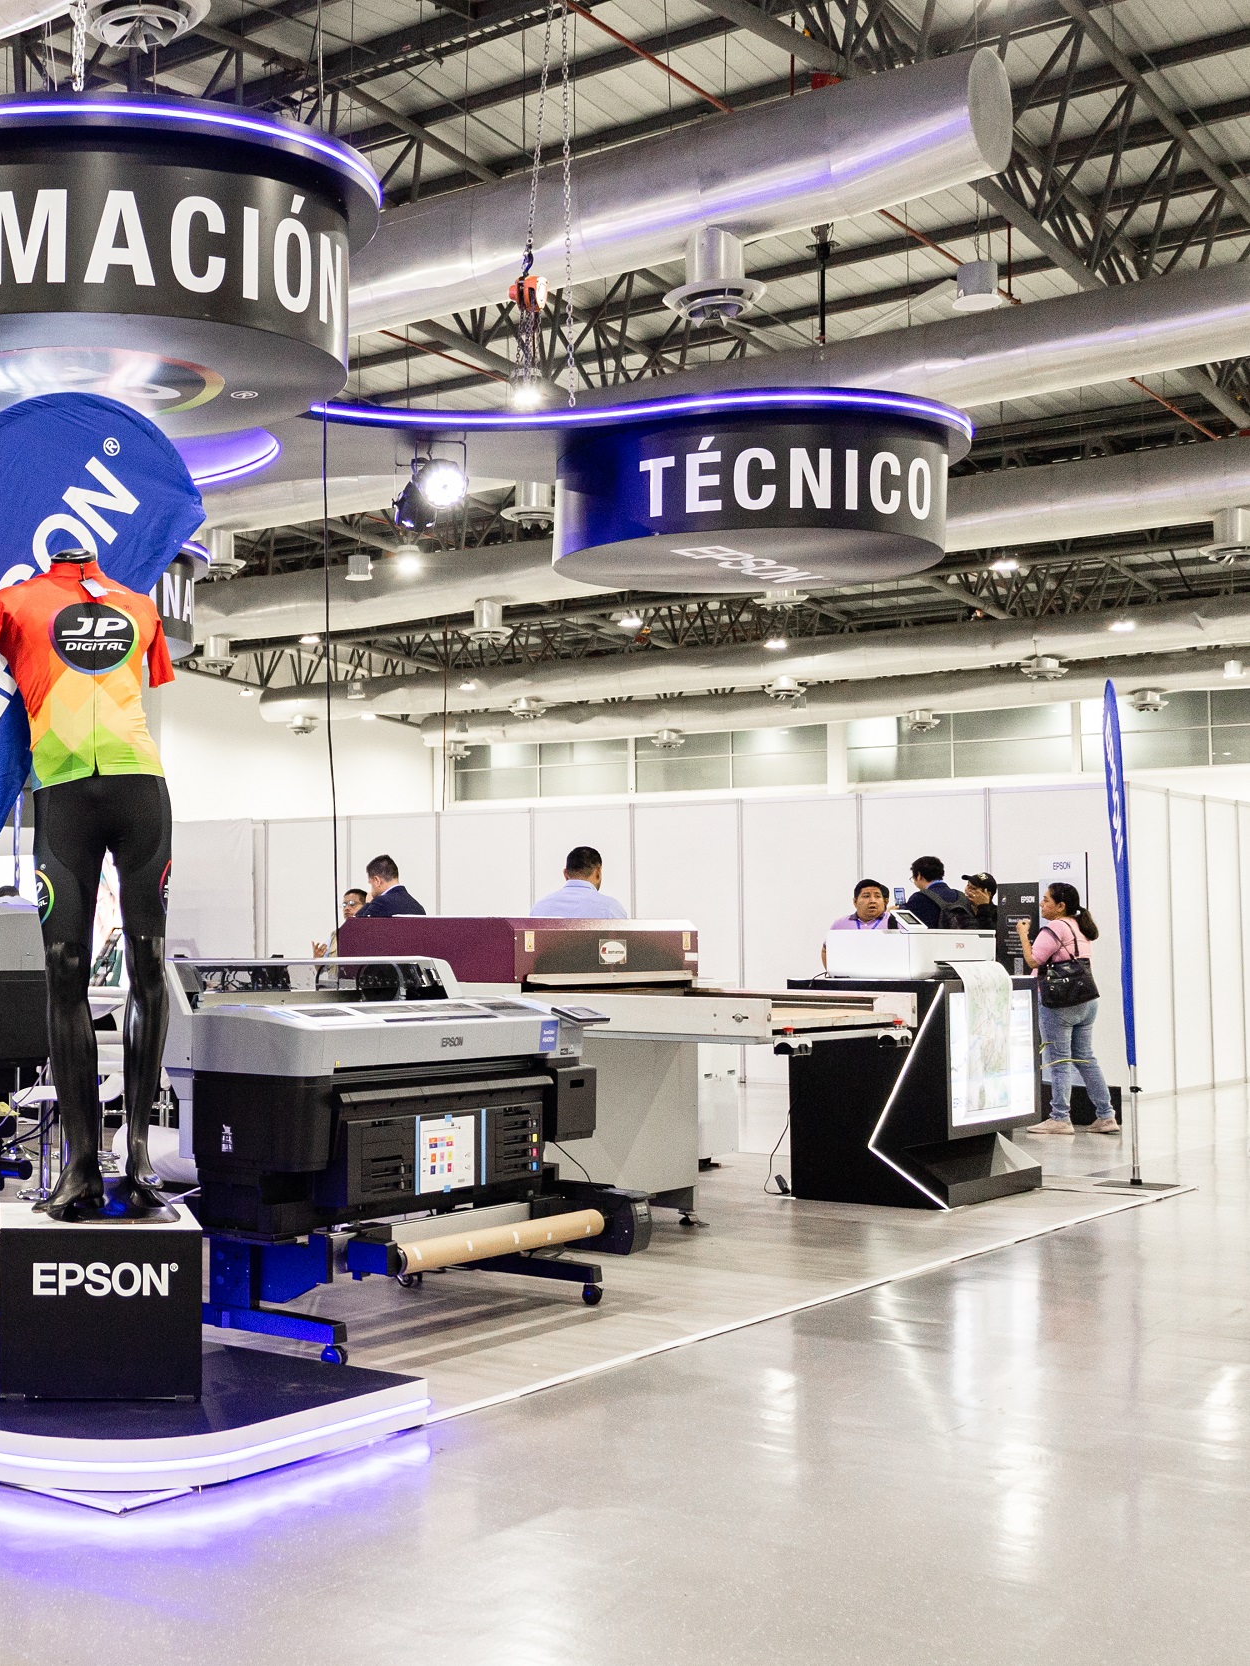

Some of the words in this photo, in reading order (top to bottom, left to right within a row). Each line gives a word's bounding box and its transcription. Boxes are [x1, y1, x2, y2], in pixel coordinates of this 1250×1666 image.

[639, 436, 931, 520] TÉCNICO
[61, 617, 128, 637] JP
[65, 642, 127, 651] DIGITAL
[1053, 862, 1071, 870] EPSON
[441, 1036, 464, 1047] EPSON
